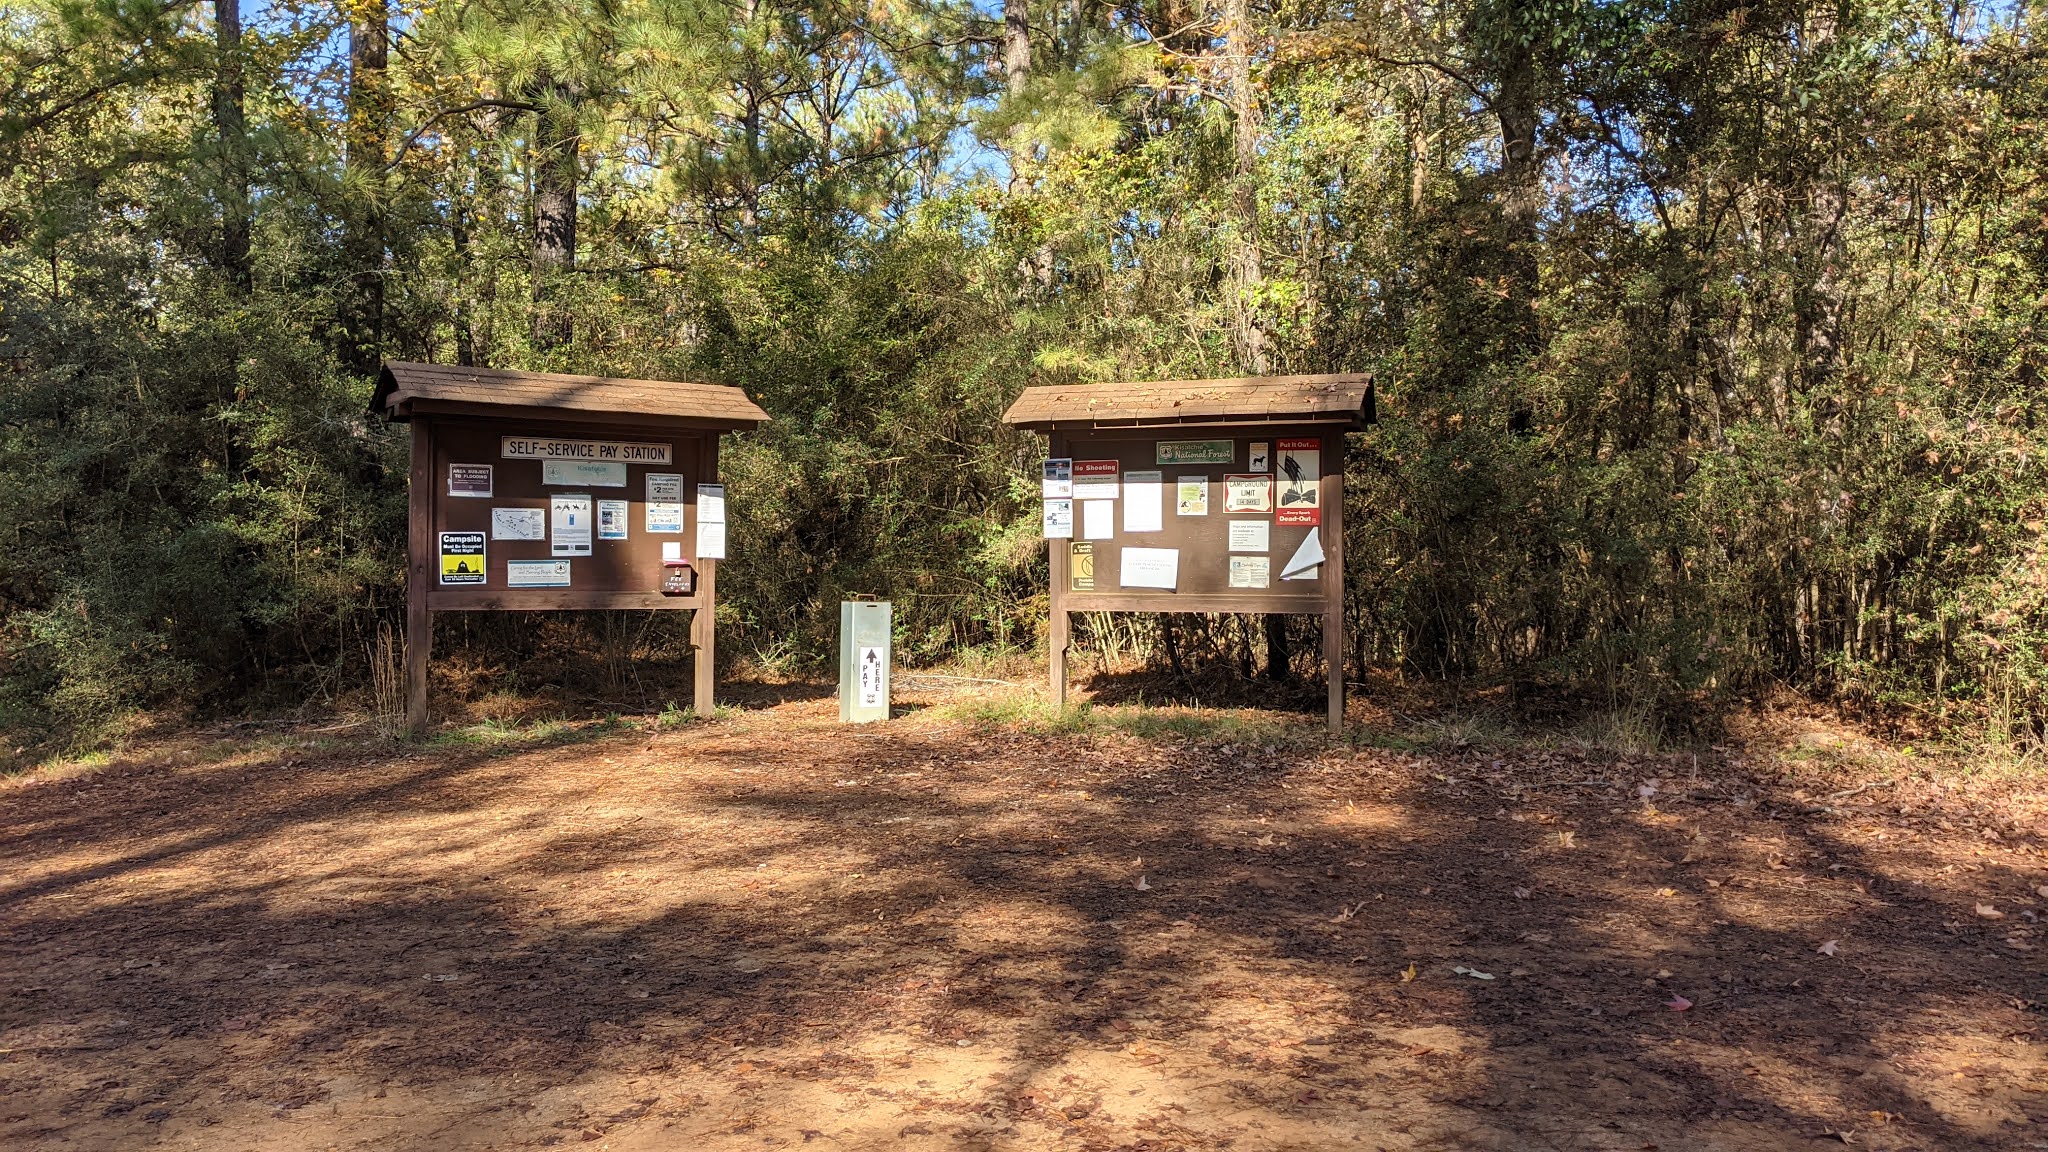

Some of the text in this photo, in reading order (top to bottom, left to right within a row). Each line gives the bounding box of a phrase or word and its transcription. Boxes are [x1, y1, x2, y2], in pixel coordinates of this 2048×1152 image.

[509, 441, 665, 460] SELF-SERVICE PAY STATION
[1175, 448, 1231, 459] National Forest
[443, 535, 482, 543] Campsite
